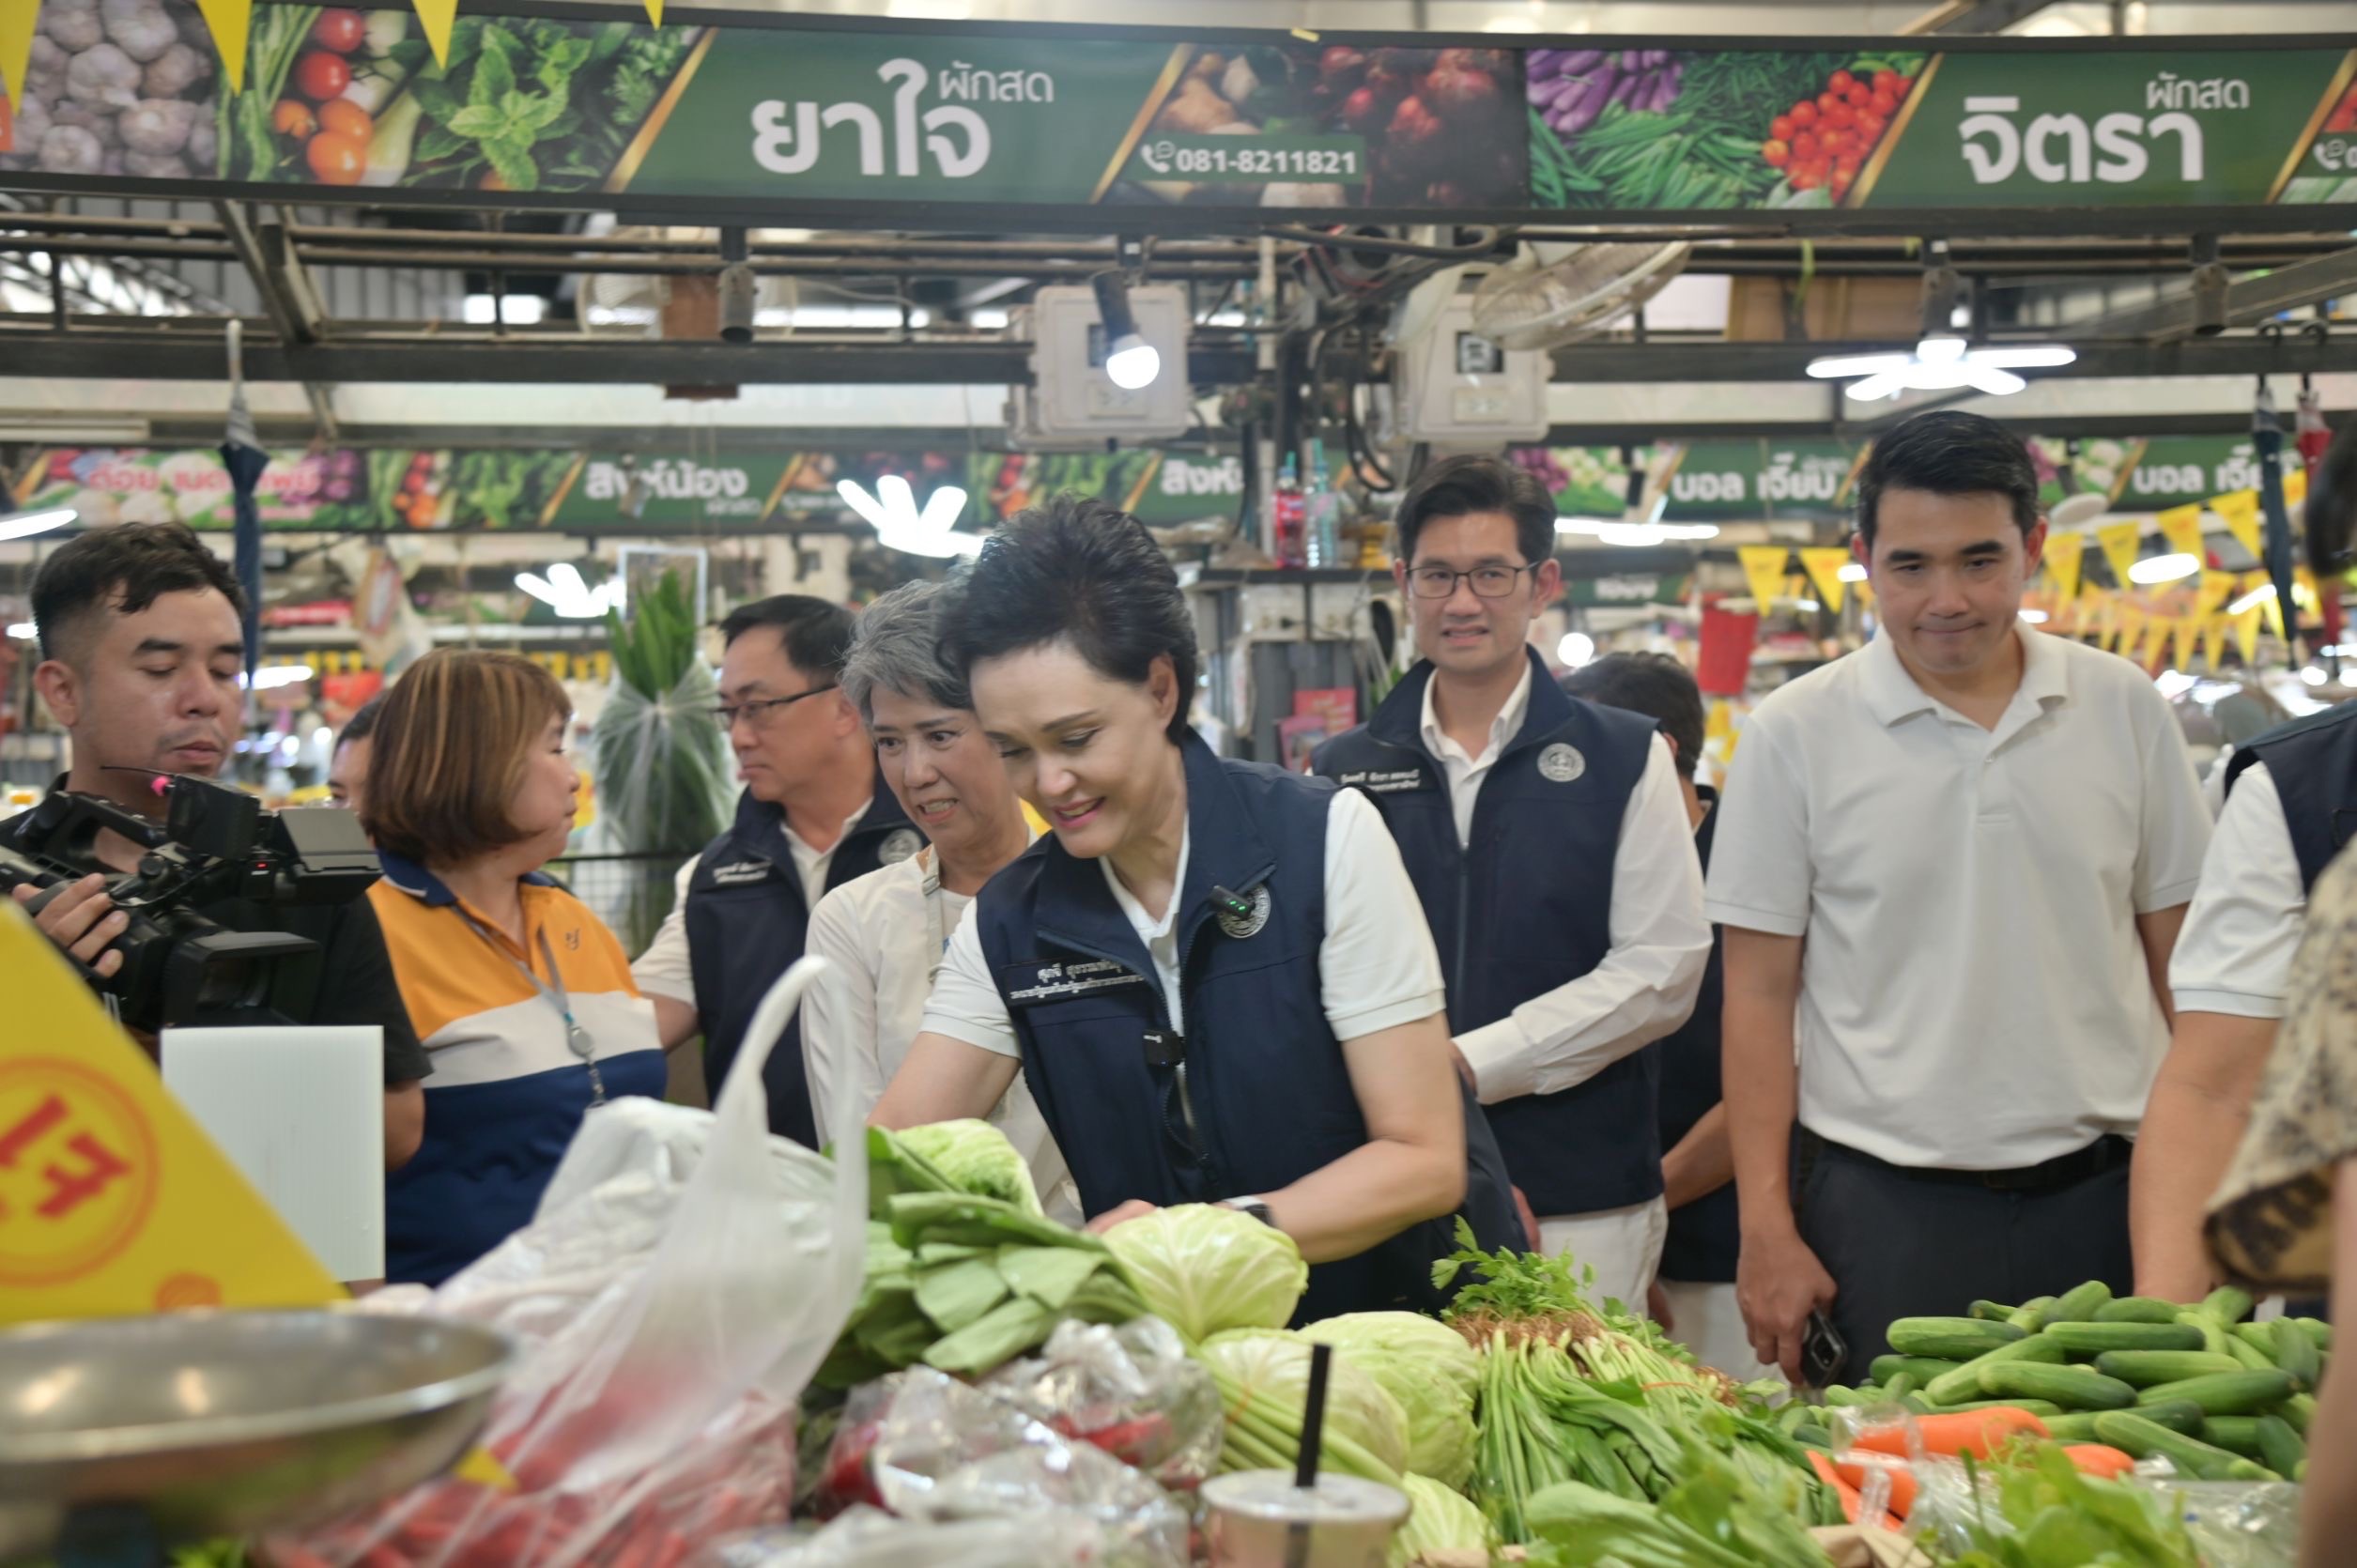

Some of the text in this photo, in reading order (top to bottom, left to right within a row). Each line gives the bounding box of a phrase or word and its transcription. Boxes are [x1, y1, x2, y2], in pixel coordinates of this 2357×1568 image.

[939, 60, 1054, 102] ผักสด
[2147, 71, 2249, 110] ผักสด
[751, 57, 991, 178] ยาใจ
[1959, 96, 2204, 184] จิตรา
[1176, 148, 1356, 174] 081-8211821
[1672, 472, 1746, 502] บอล
[2132, 464, 2206, 495] บอล
